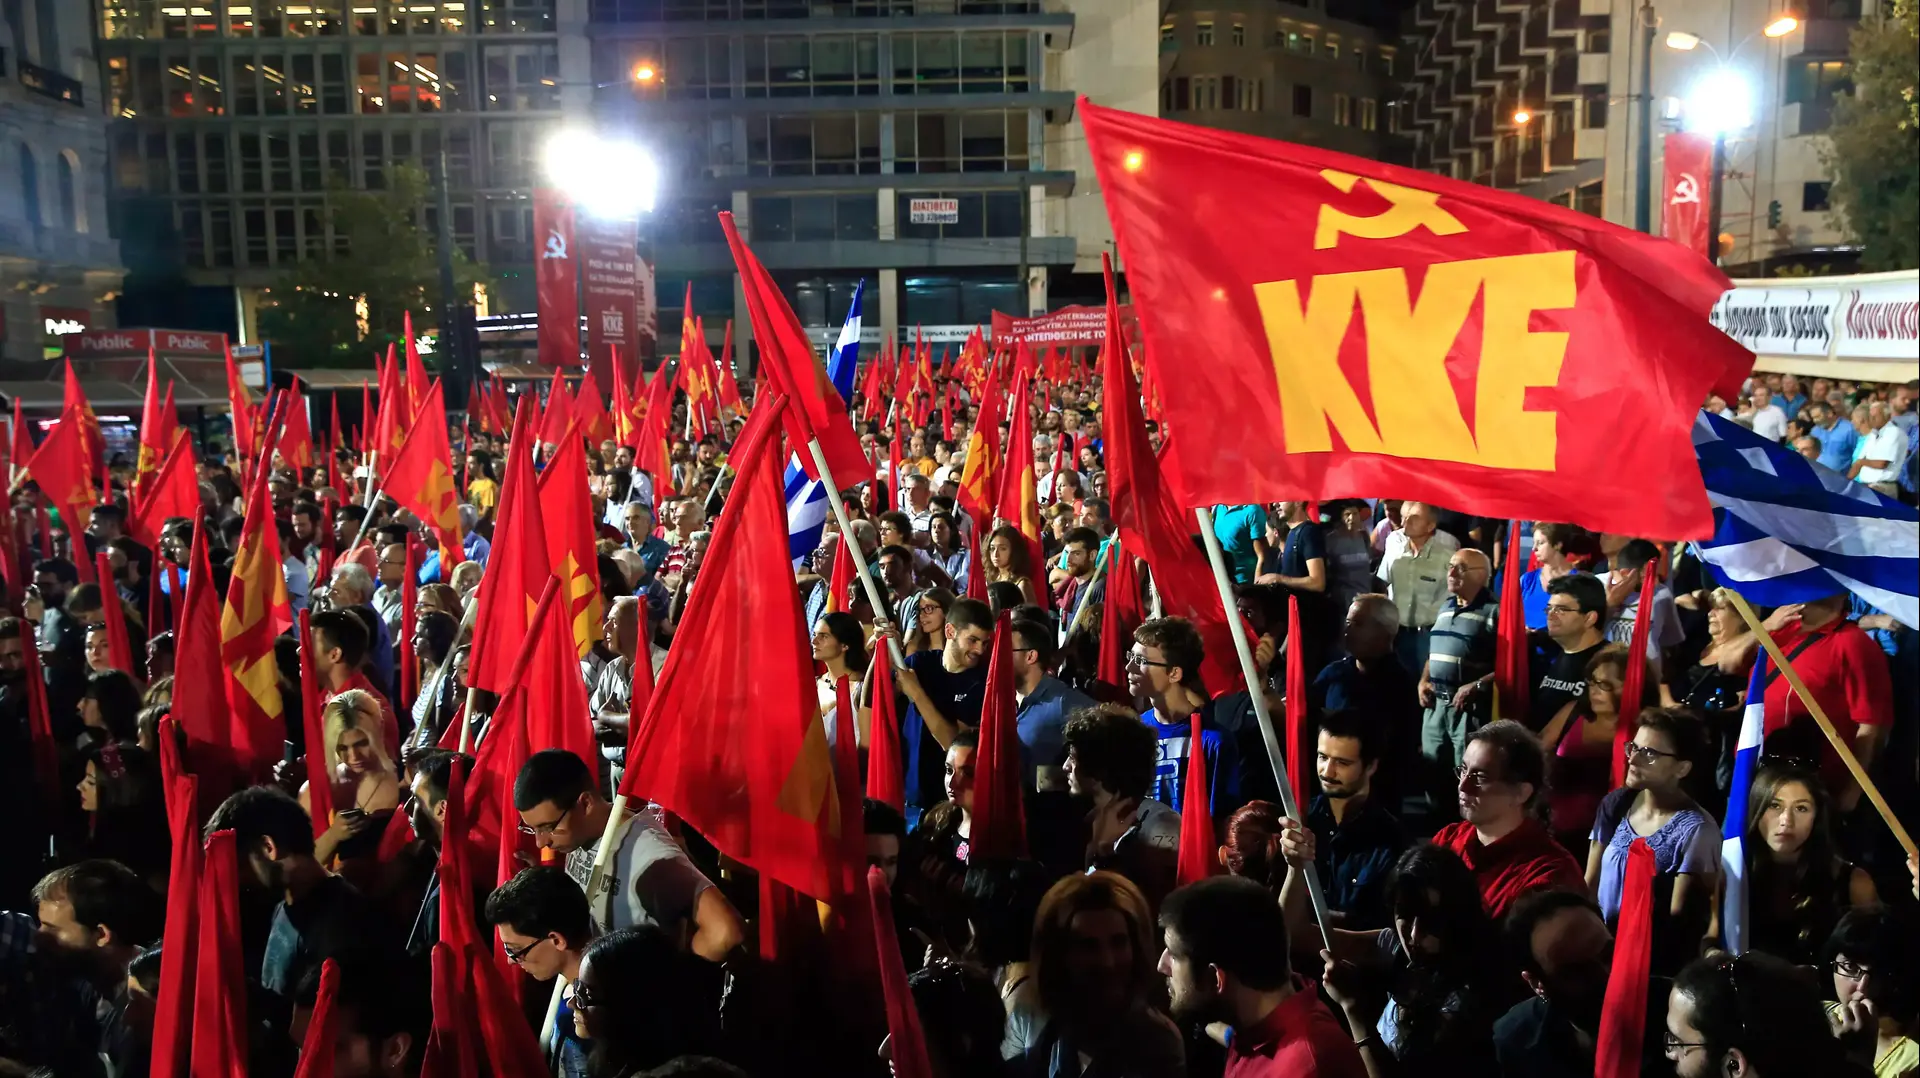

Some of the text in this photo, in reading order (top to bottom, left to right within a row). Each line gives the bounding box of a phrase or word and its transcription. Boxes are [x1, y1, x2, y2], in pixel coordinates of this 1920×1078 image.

[912, 201, 957, 212] ΔΙΑΤΙΘΕΤΑΙ
[1846, 290, 1919, 340] Κοινωνικο
[81, 334, 134, 350] Public
[168, 334, 210, 350] Public
[1079, 331, 1092, 340] ΜΕ
[1253, 250, 1577, 472] ΚΚΕ
